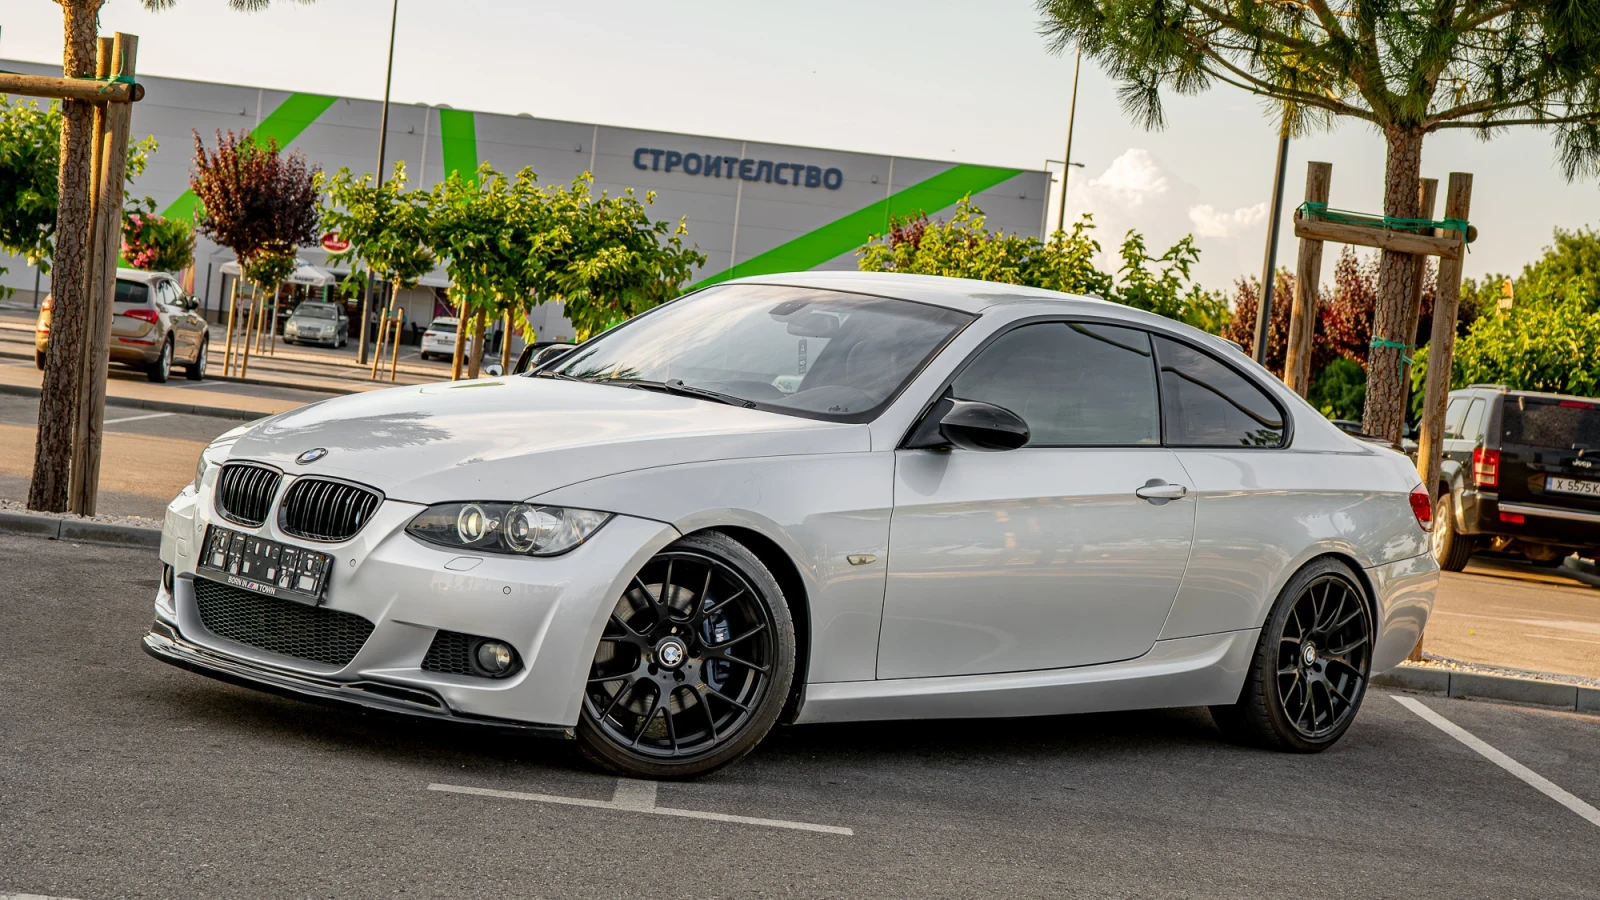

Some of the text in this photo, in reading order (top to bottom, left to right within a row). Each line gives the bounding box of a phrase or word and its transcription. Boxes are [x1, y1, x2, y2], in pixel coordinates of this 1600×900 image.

[633, 147, 843, 190] СТРОИТЕЛСТВО
[1572, 459, 1592, 468] Jeep
[1557, 480, 1563, 490] X
[1568, 480, 1591, 493] 5575
[228, 576, 242, 586] BORN
[259, 584, 276, 595] TOWN
